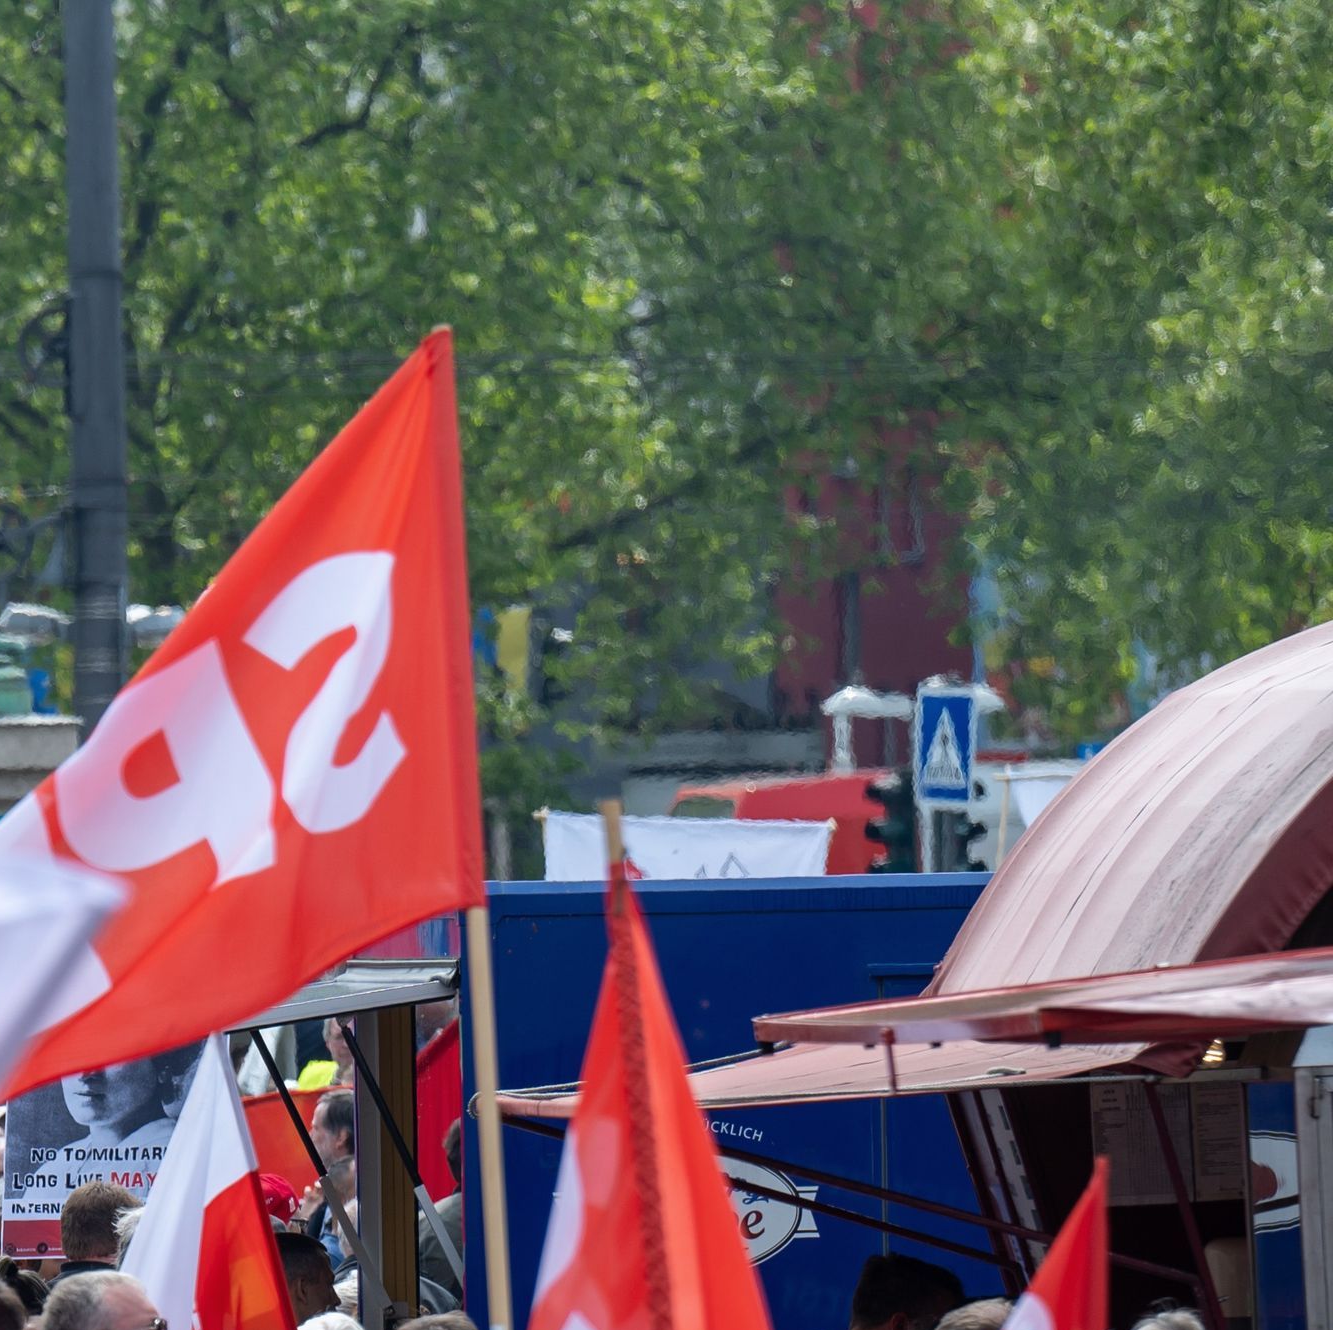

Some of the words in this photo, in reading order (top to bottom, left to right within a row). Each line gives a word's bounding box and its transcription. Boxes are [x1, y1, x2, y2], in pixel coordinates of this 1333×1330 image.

[31, 1148, 57, 1162] NO
[64, 1148, 86, 1162] TO
[12, 1203, 63, 1214] INTERN
